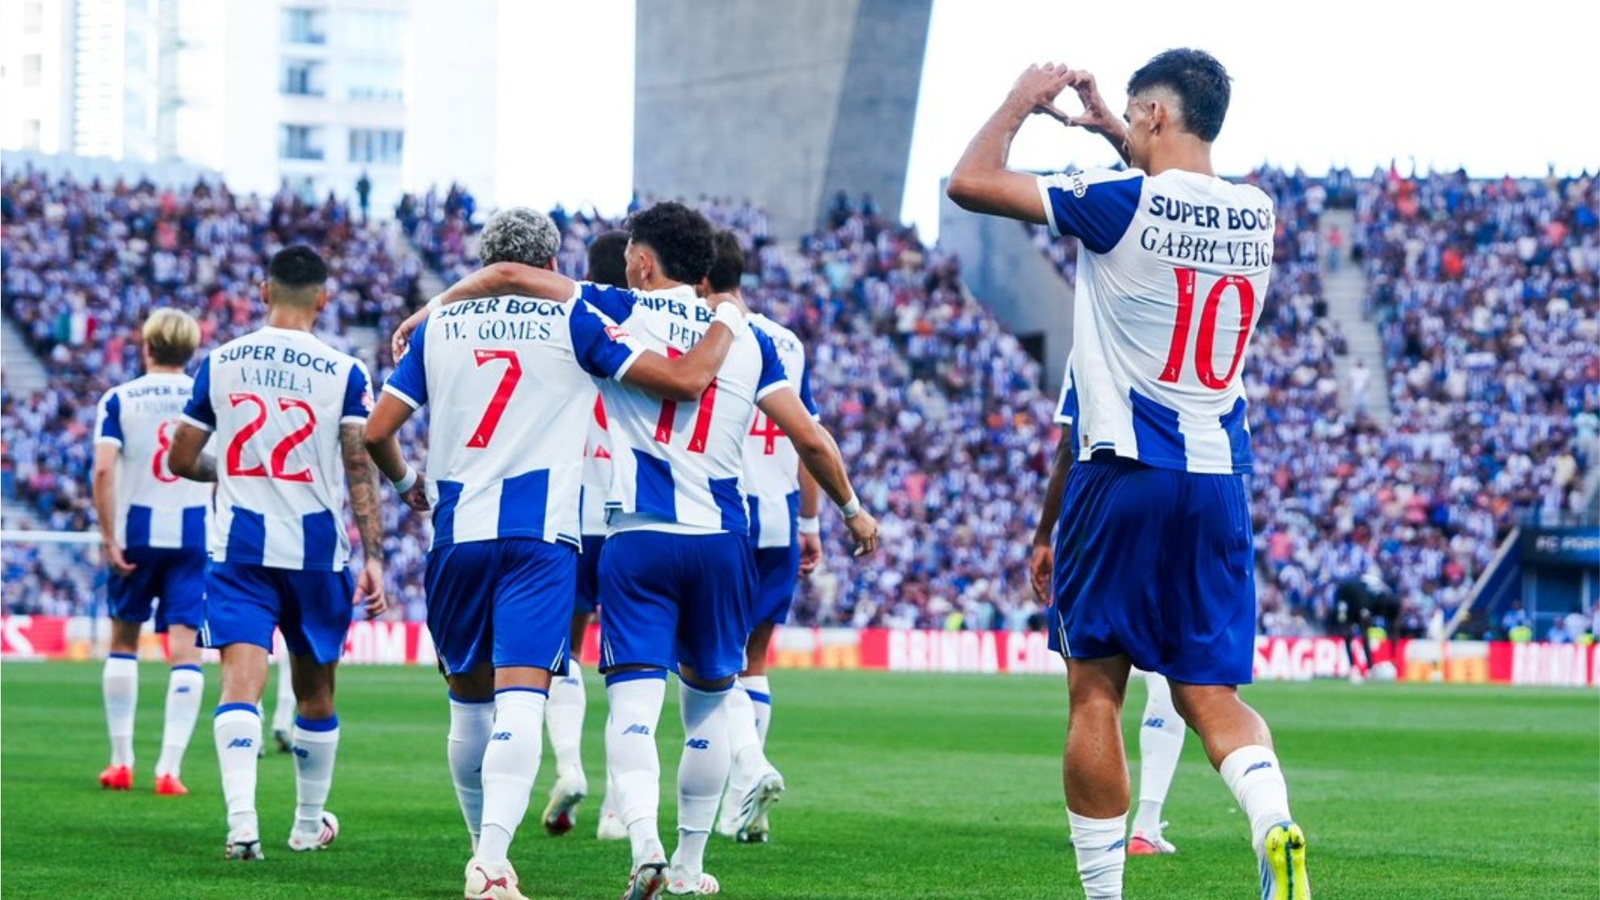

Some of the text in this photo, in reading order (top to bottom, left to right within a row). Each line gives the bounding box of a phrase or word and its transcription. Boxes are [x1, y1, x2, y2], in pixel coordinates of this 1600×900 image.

[1149, 195, 1221, 229] SUPER
[1140, 226, 1217, 263] GABRI
[445, 320, 552, 341] W. GOMES
[1158, 267, 1255, 391] 10
[218, 344, 339, 376] SUPER BOCK
[240, 367, 313, 394] VARELA
[465, 349, 523, 449] 7
[226, 391, 318, 484] 22
